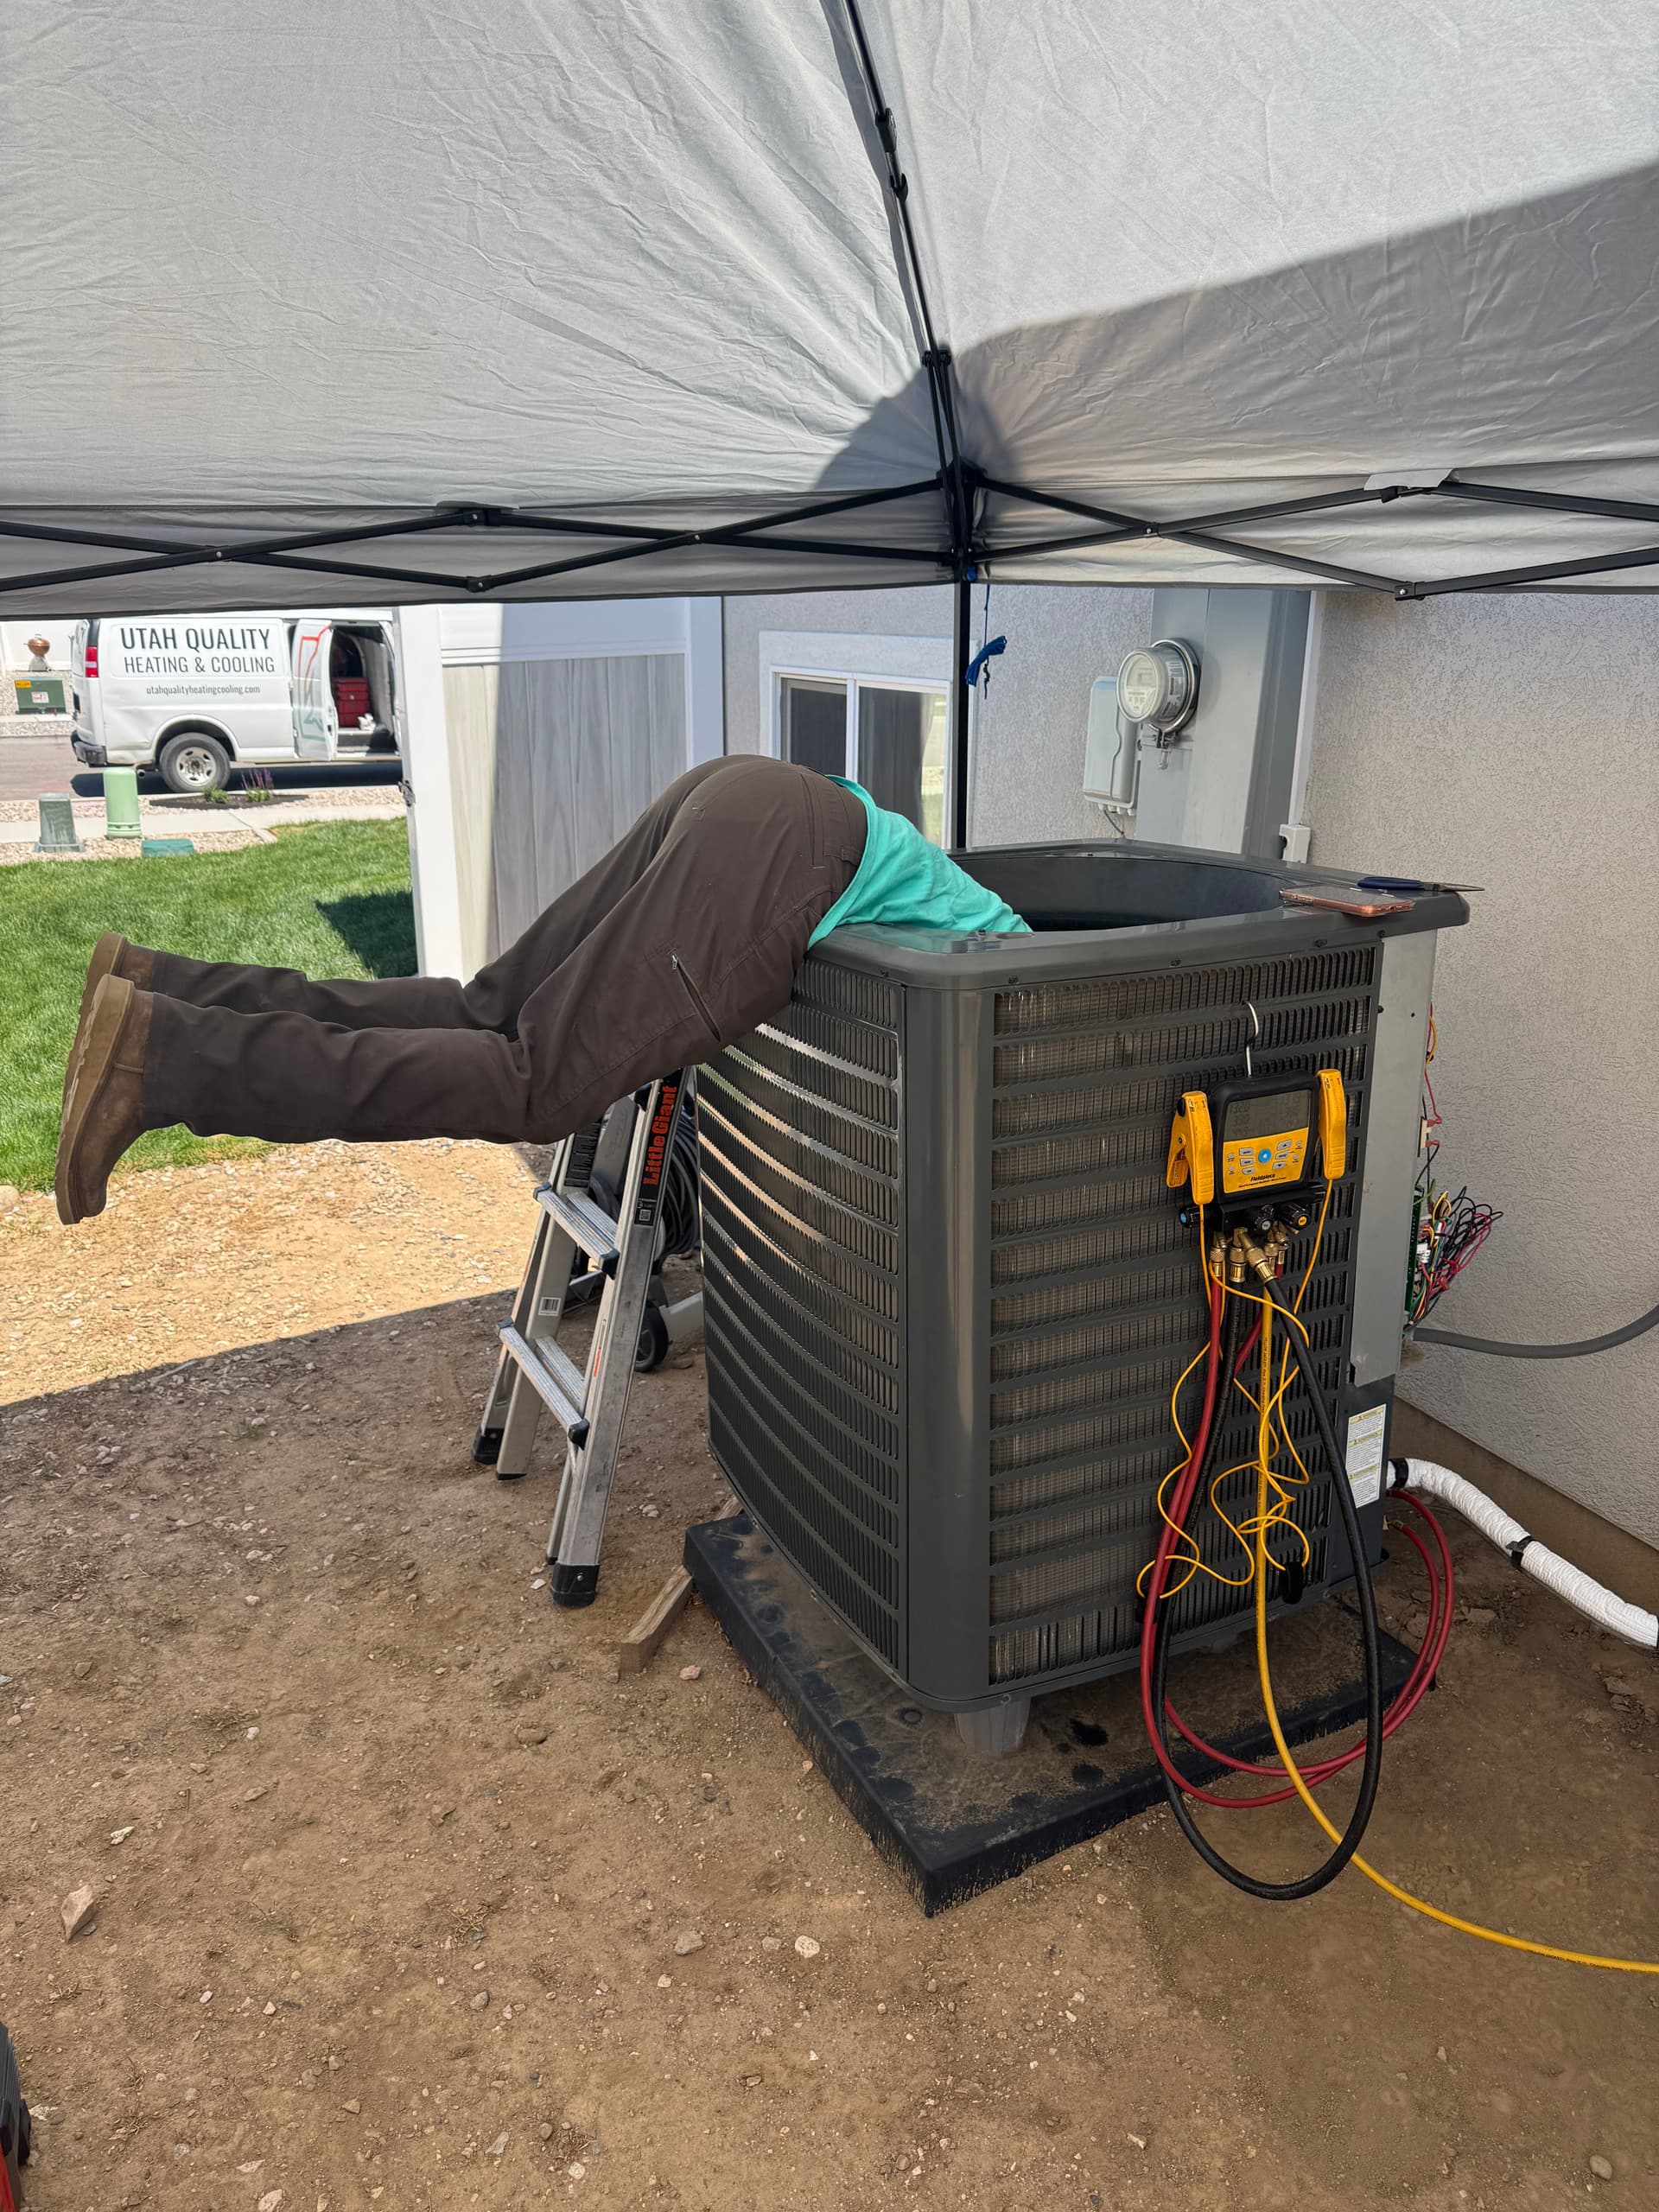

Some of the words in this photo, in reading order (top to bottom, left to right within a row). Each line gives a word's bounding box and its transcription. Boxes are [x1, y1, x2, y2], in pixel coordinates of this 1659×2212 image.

[120, 627, 178, 649] UTAH
[186, 628, 270, 652] QUALITY
[124, 657, 188, 673] HEATING
[194, 657, 206, 673] &
[212, 657, 275, 673] COOLING
[146, 684, 261, 696] utahqualityheatingcooling.com
[652, 1085, 677, 1135] Giant
[643, 1135, 665, 1185] Little
